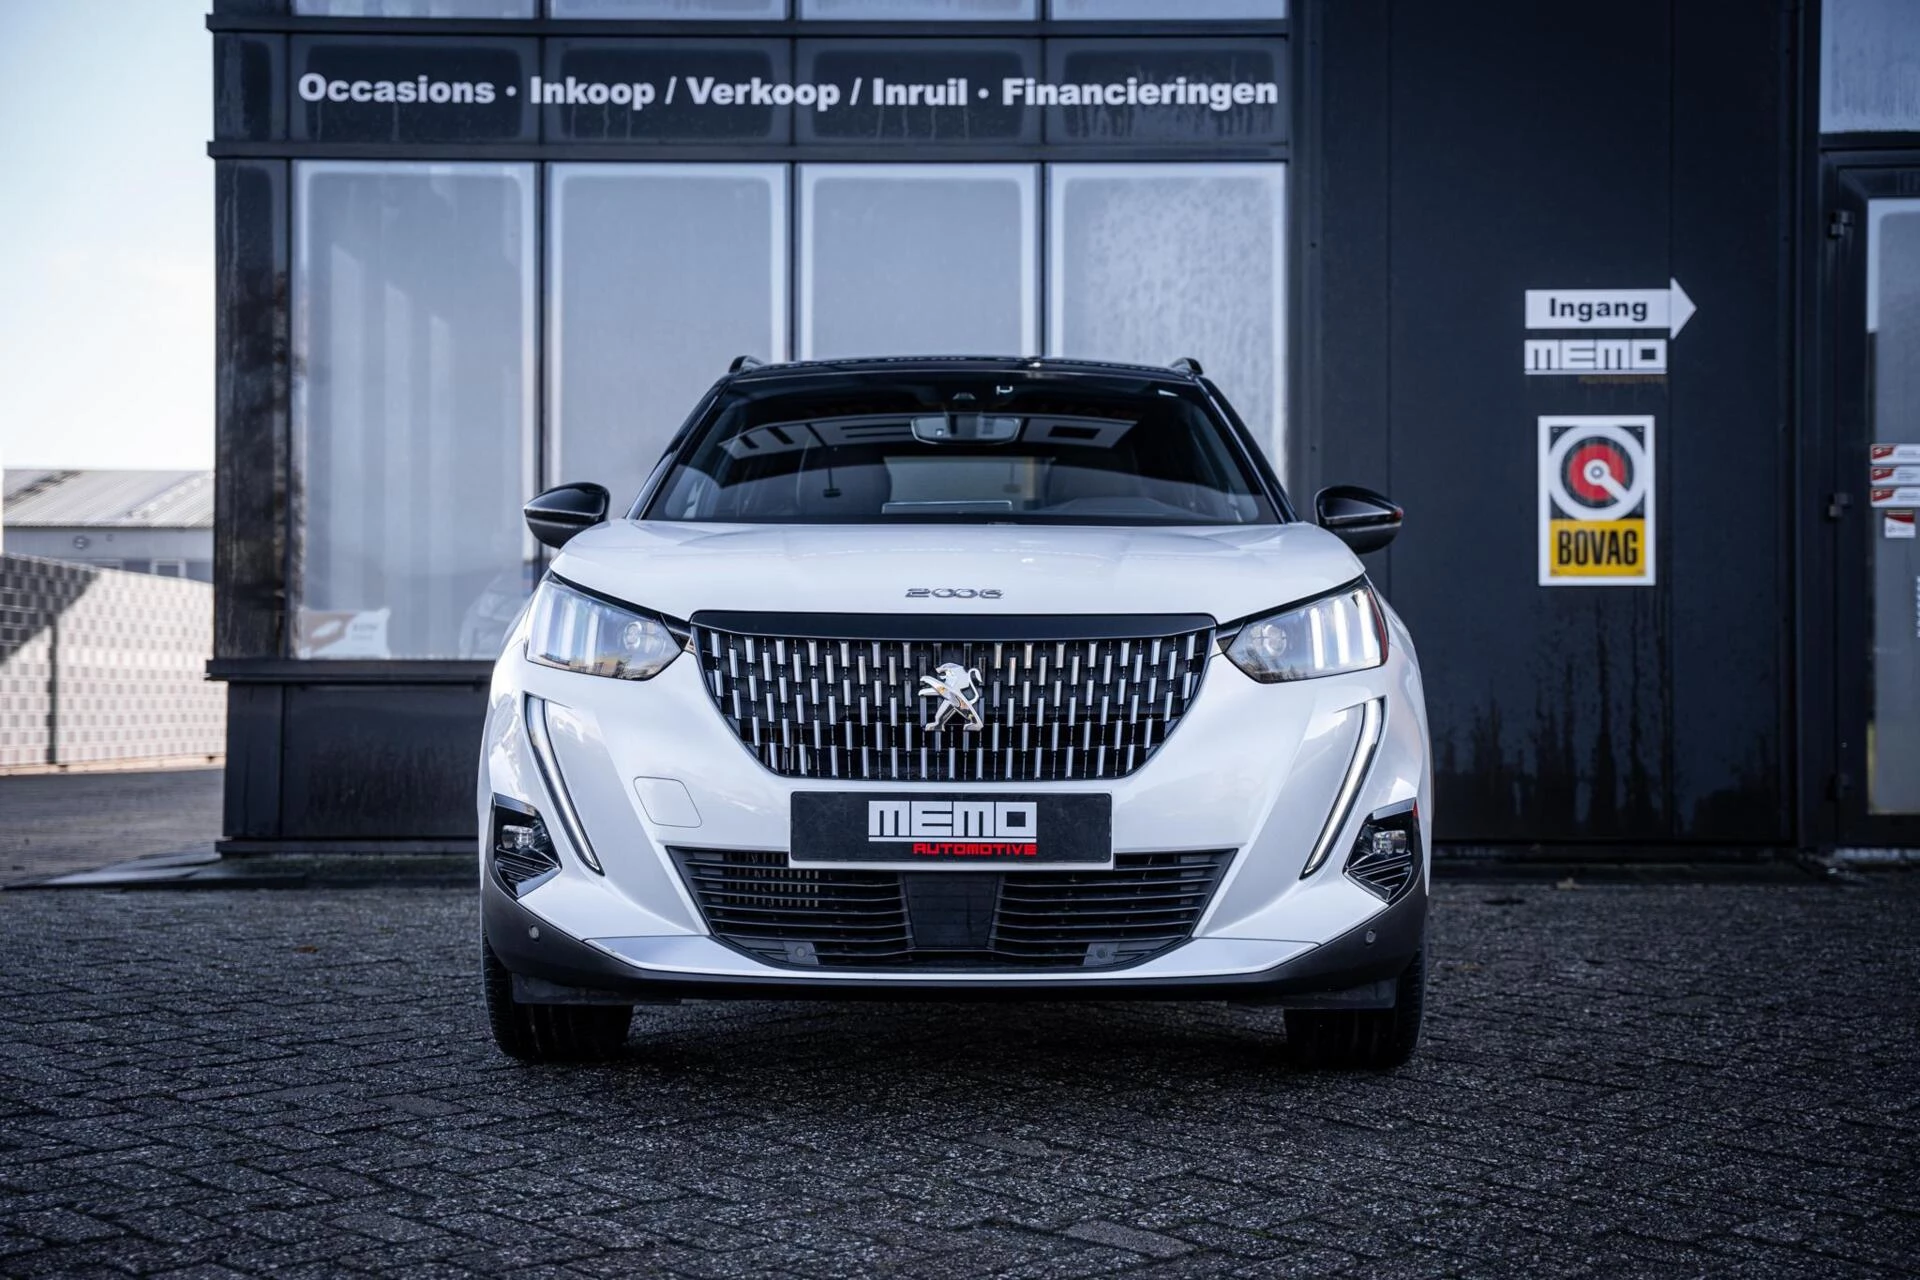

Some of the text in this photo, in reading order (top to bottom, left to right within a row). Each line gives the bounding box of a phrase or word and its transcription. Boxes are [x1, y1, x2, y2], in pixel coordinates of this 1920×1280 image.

[299, 73, 496, 103] Occasions
[530, 76, 655, 110] Inkoop
[686, 77, 841, 112] Verkoop
[873, 78, 968, 106] Inruil
[1003, 77, 1278, 111] Financieringen
[1549, 297, 1648, 322] Ingang
[1525, 339, 1667, 371] MEMO
[1557, 530, 1638, 565] BOVAG
[868, 801, 1037, 837] MEMO
[912, 842, 1037, 855] AUTOMOTIVE
